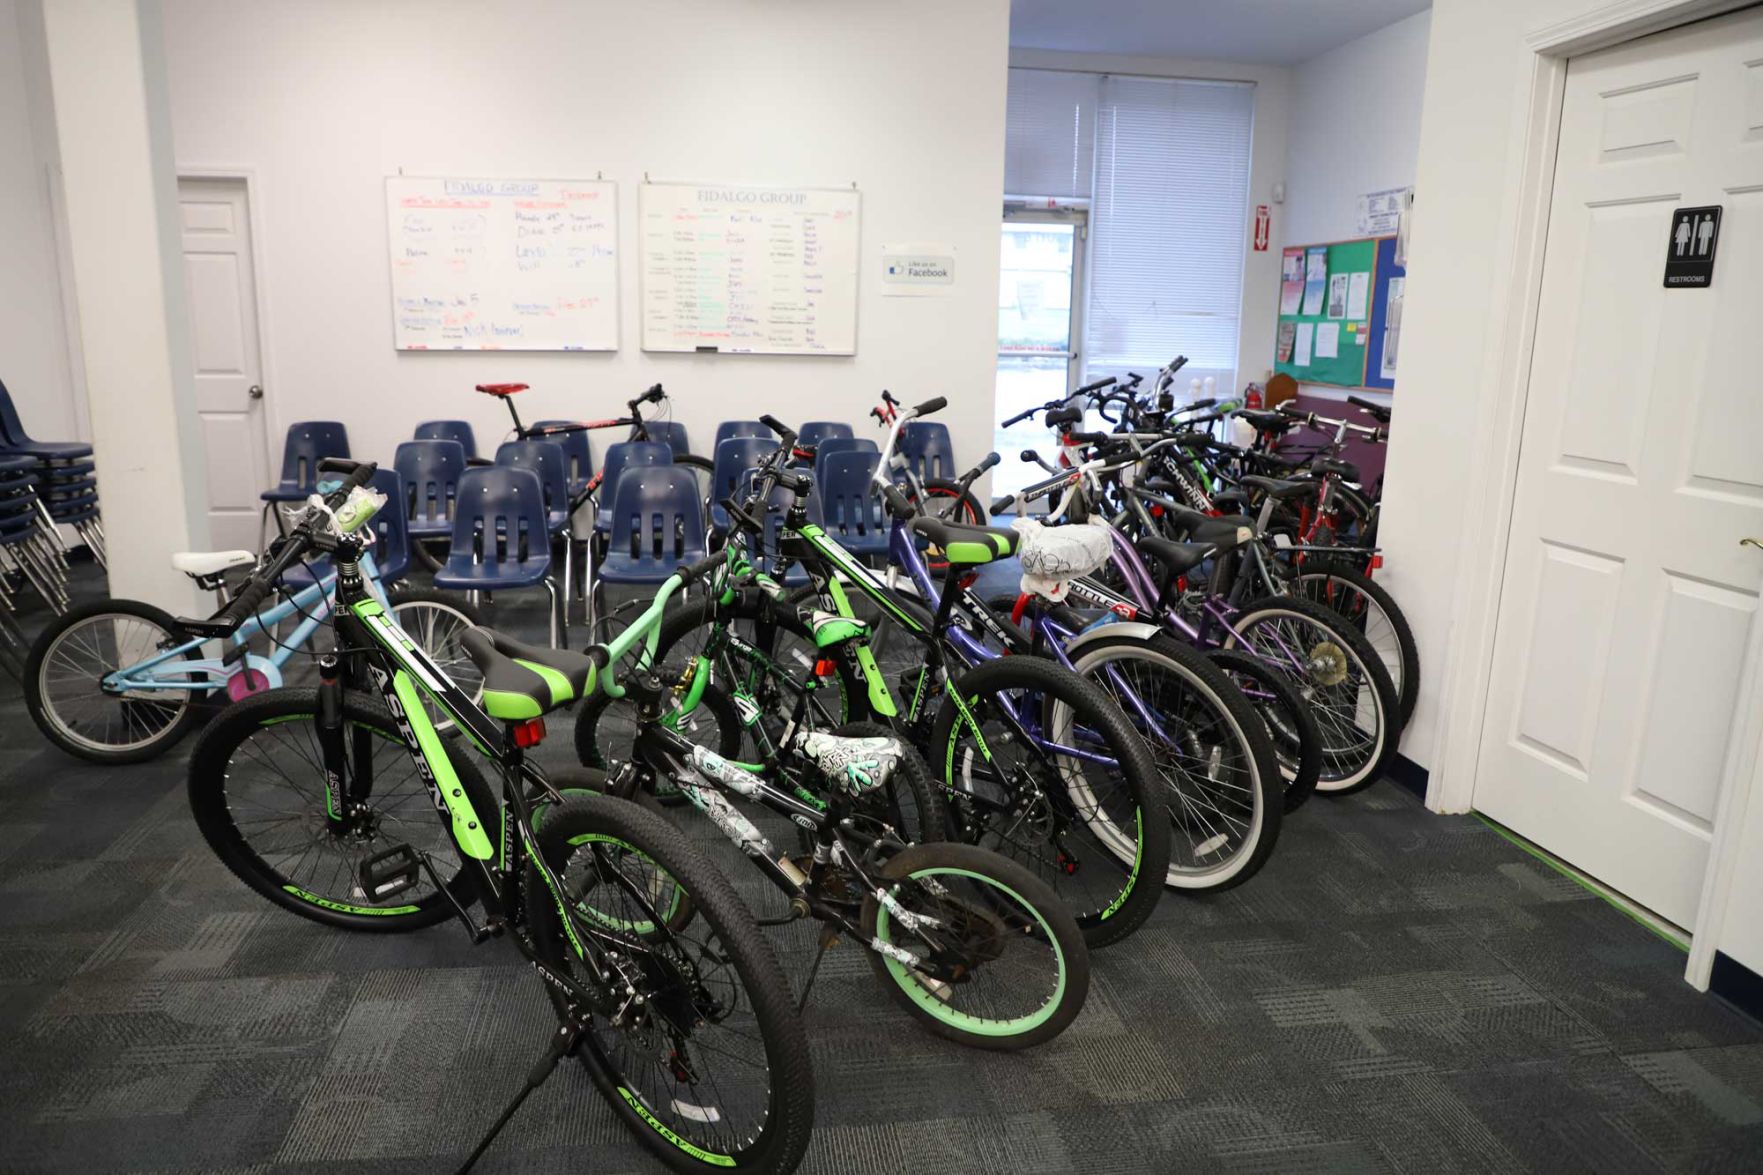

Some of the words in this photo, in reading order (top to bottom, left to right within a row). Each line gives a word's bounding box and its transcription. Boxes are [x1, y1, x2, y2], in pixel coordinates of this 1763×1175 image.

[697, 190, 757, 203] FIDALGO
[759, 191, 807, 205] GROUP
[908, 267, 947, 277] Facebook
[1668, 275, 1705, 283] RESTROOMS
[1068, 580, 1118, 609] ROTTLE
[963, 592, 1016, 647] TREK
[368, 662, 451, 816] ASPEN
[329, 769, 342, 815] ASPEN
[505, 809, 514, 865] ASPEN
[295, 887, 359, 913] ASPEN
[627, 1096, 688, 1148] ASPEN
